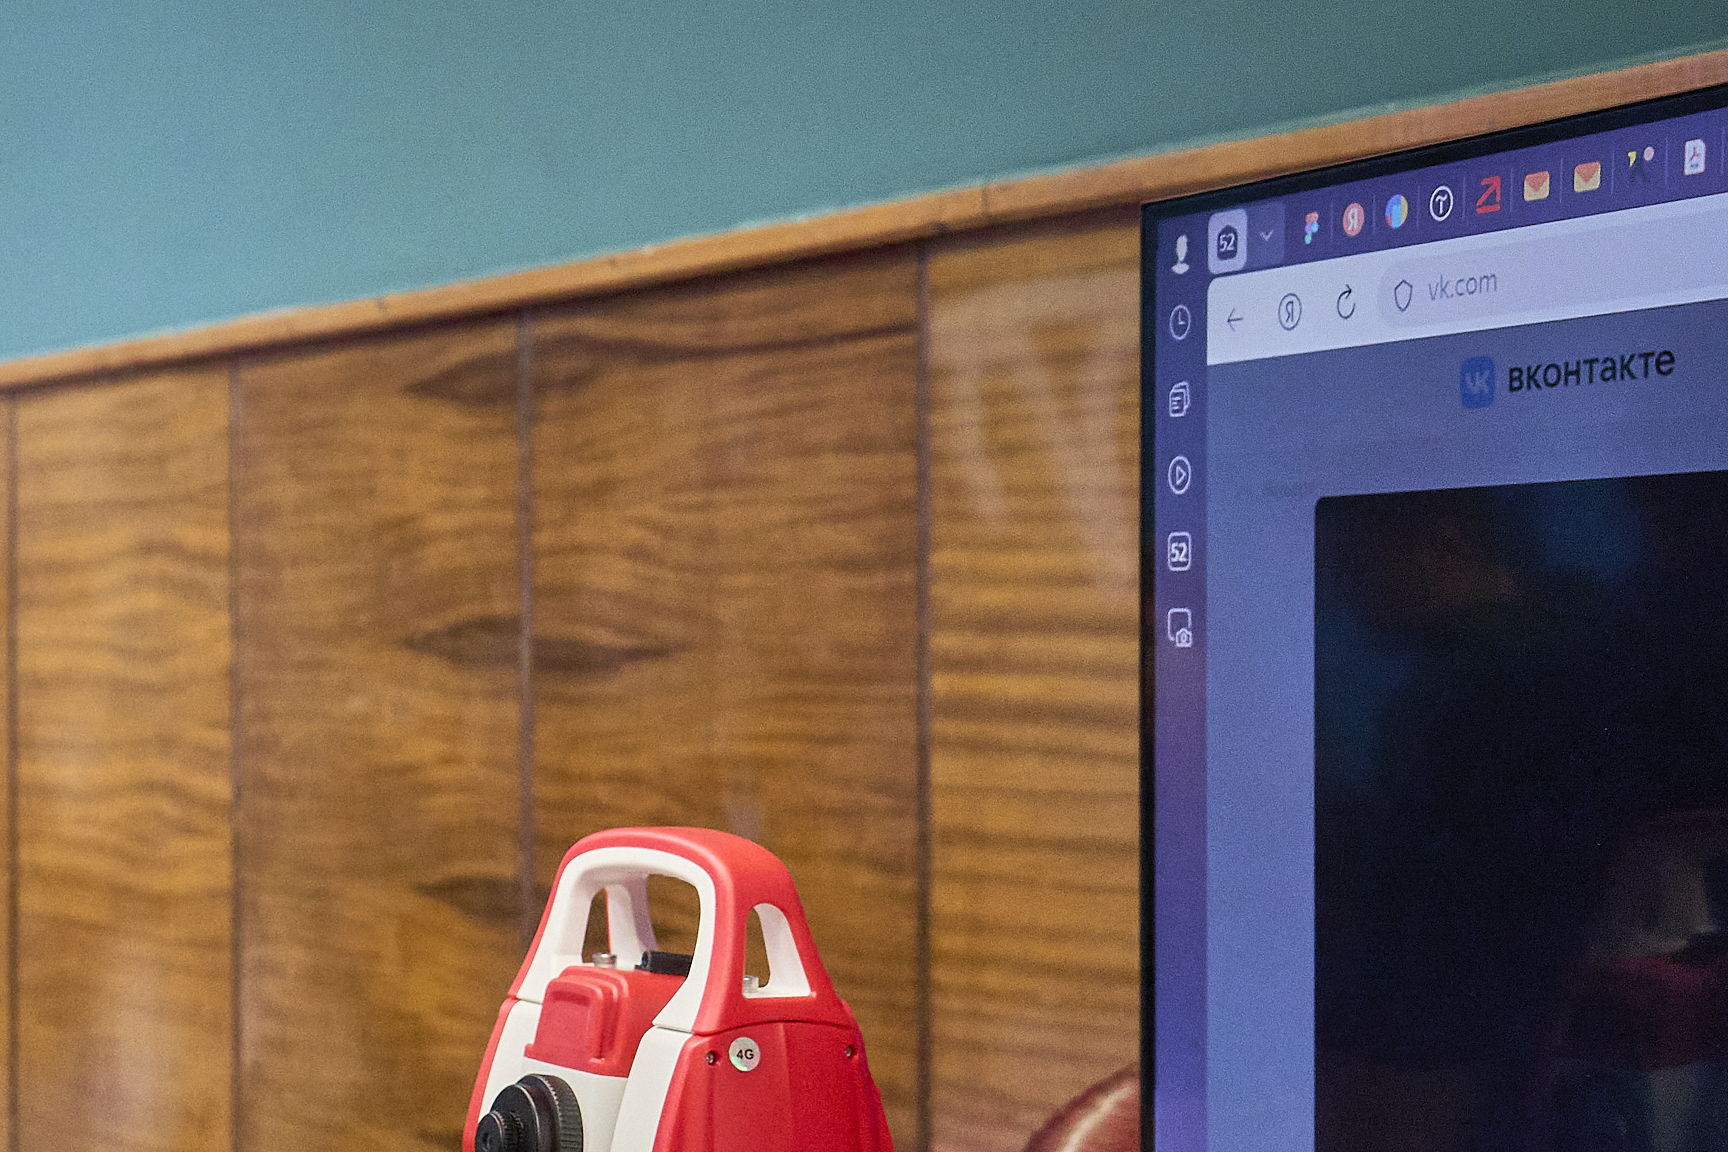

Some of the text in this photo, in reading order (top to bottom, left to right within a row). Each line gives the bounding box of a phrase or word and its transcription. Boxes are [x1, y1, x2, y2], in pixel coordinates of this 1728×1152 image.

[1428, 271, 1498, 302] vk.com
[1171, 541, 1187, 562] 52
[736, 1048, 754, 1060] 4G
